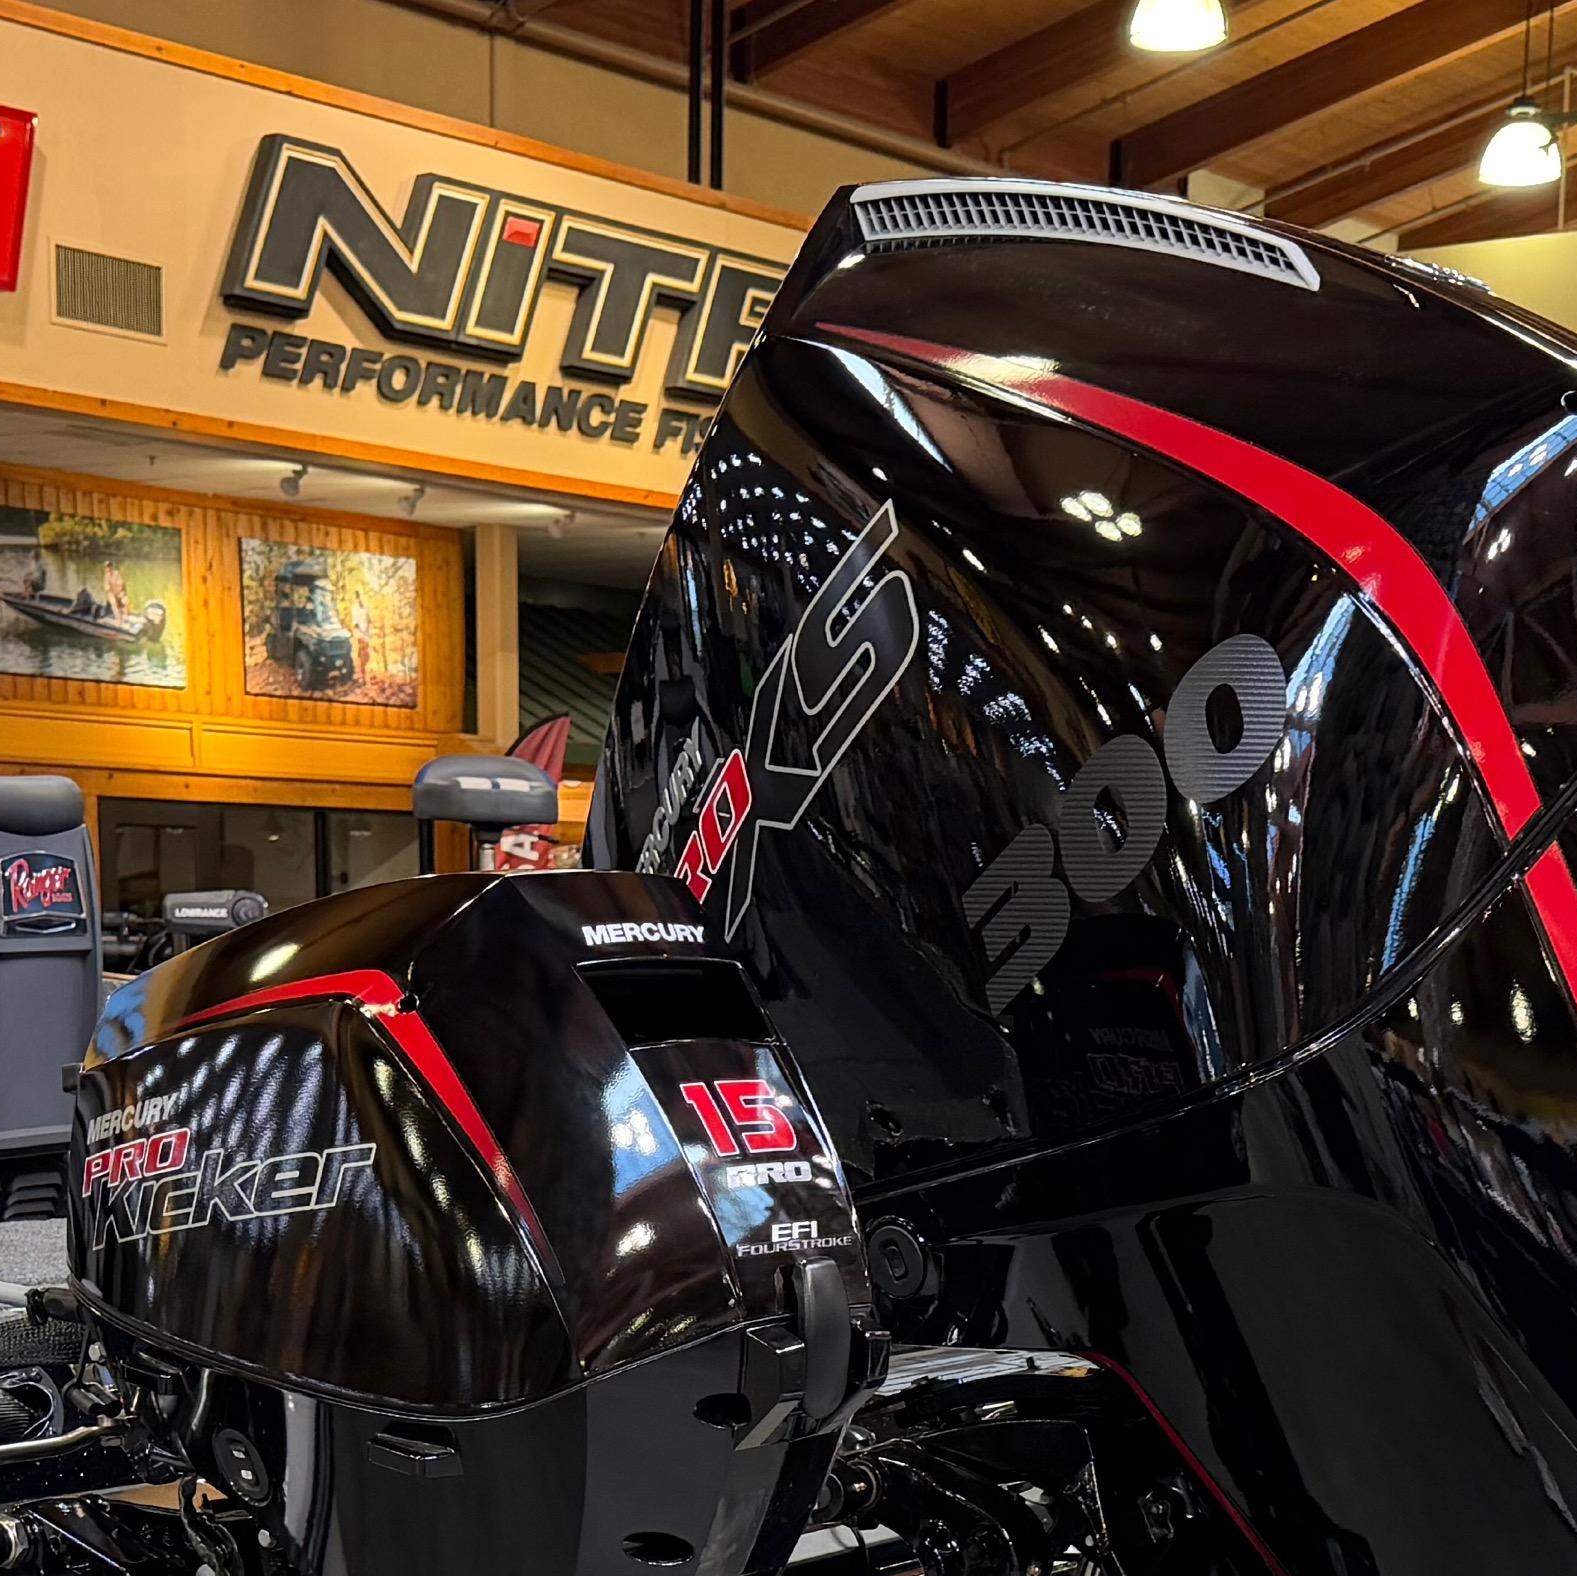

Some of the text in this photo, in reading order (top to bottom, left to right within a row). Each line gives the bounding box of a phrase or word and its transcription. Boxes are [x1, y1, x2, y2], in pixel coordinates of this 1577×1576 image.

[221, 323, 649, 445] PERFORMANCE
[961, 633, 1288, 1017] 300
[4, 858, 72, 912] Ranger
[174, 907, 229, 919] LOWRANCE
[581, 922, 705, 947] MERCURY
[87, 1092, 181, 1145] MERCURY
[680, 1080, 798, 1157] 15
[82, 1127, 191, 1198] PRO
[771, 1220, 818, 1243] EFI
